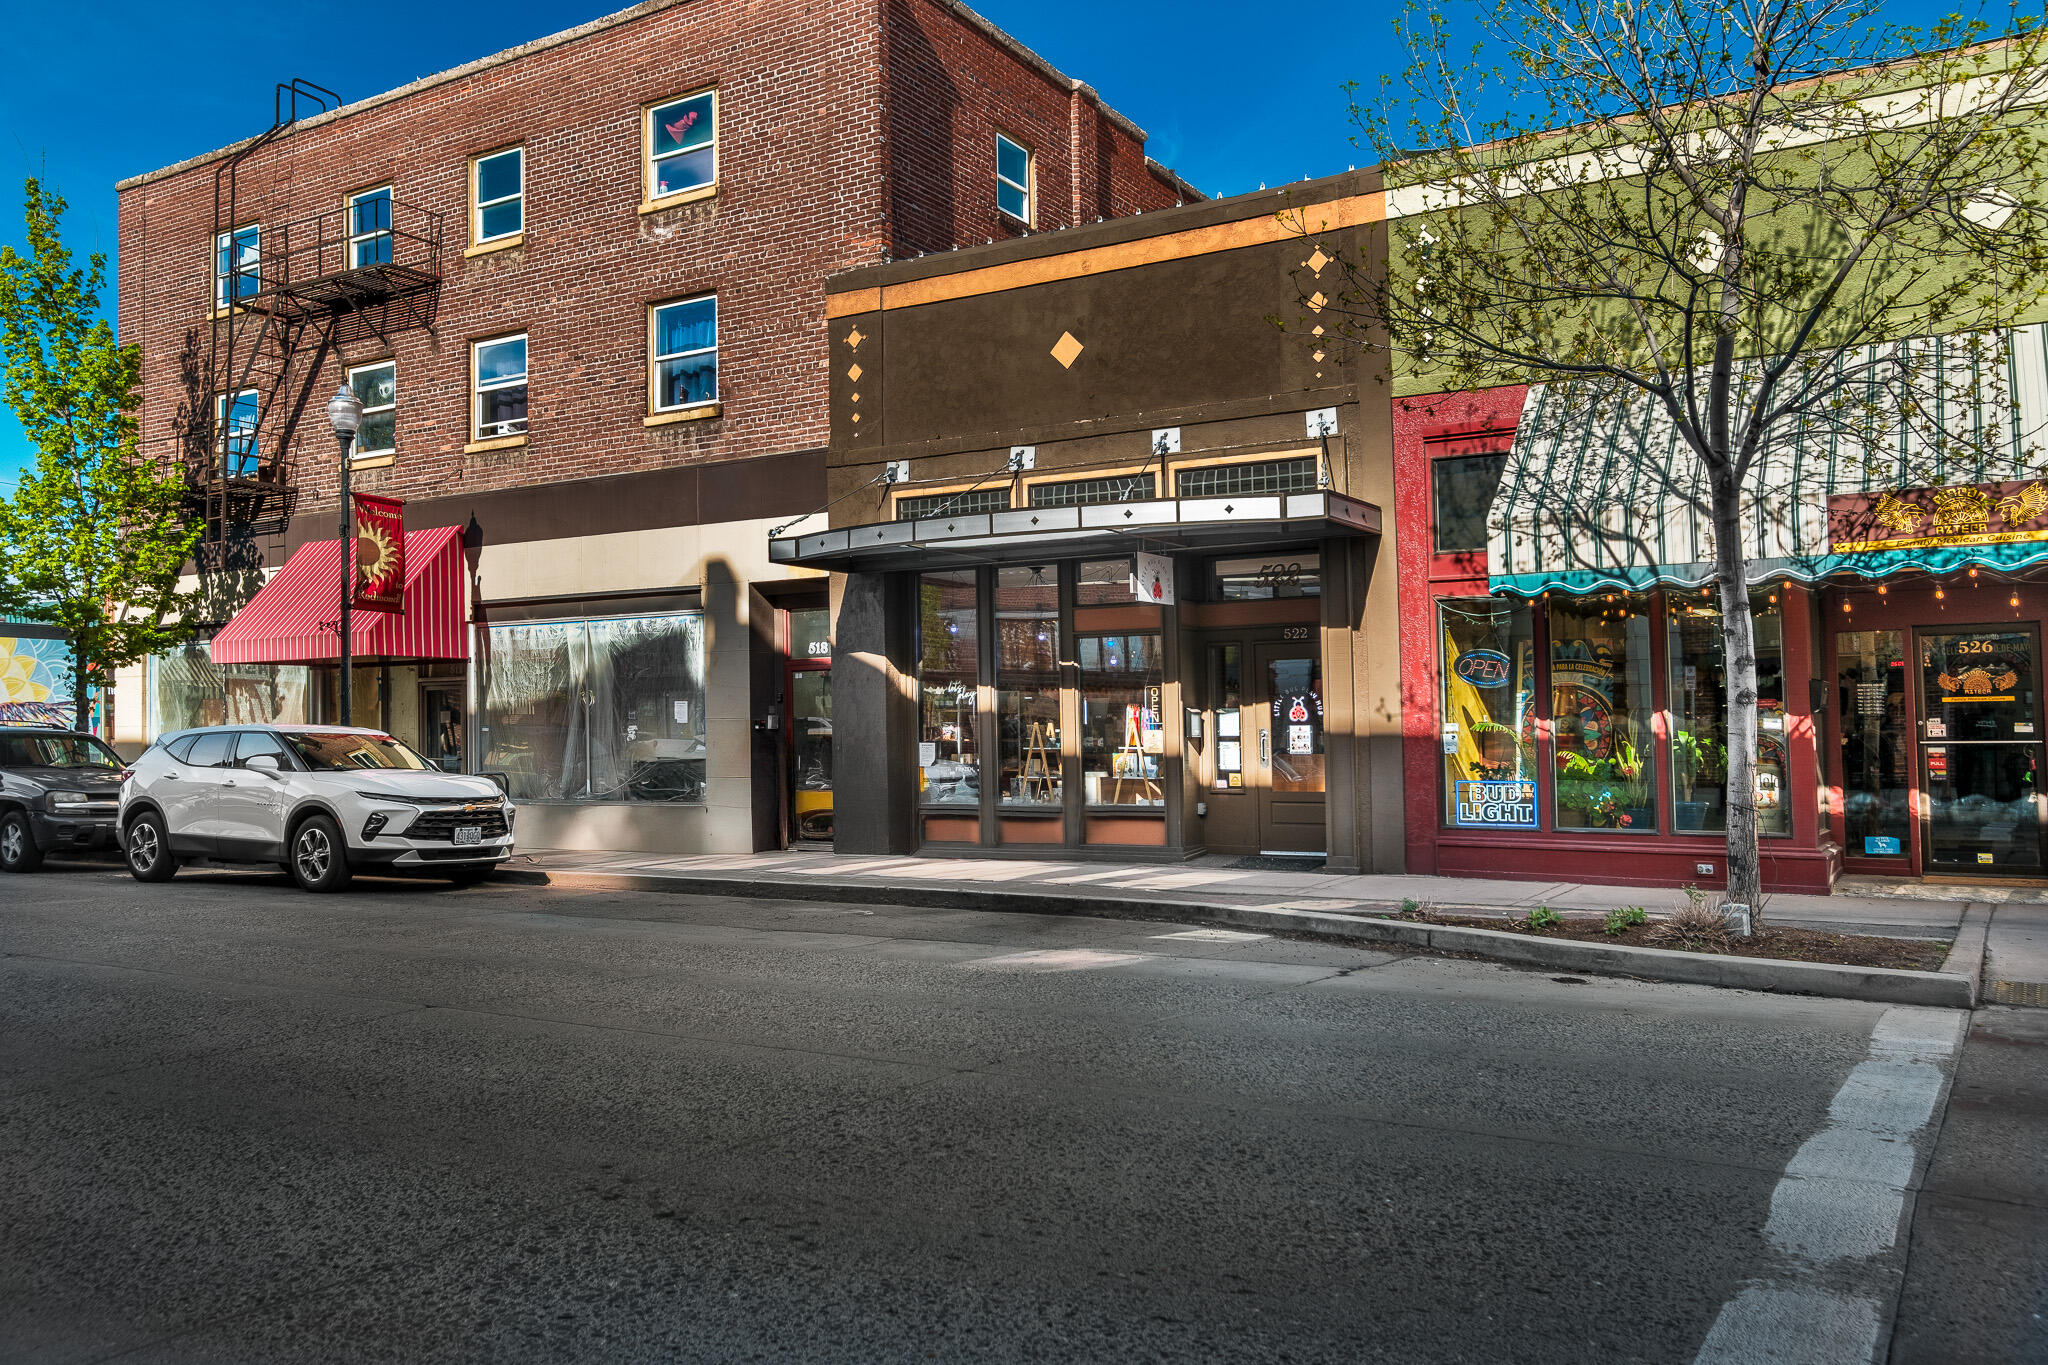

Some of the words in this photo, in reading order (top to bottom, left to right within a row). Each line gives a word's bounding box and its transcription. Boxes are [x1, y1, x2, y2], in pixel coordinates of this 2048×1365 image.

[359, 505, 402, 520] Welcome
[1936, 524, 1987, 534] AZTECA
[1896, 539, 1933, 548] Family
[1936, 536, 1983, 545] Mexican
[1987, 533, 2031, 542] Cuisine
[1254, 563, 1301, 588] 522
[1284, 627, 1308, 639] 522
[808, 641, 829, 655] 518
[1959, 641, 1993, 654] 526
[1459, 658, 1510, 679] OPEN
[1150, 687, 1160, 722] OPEN
[1470, 784, 1522, 803] BUD
